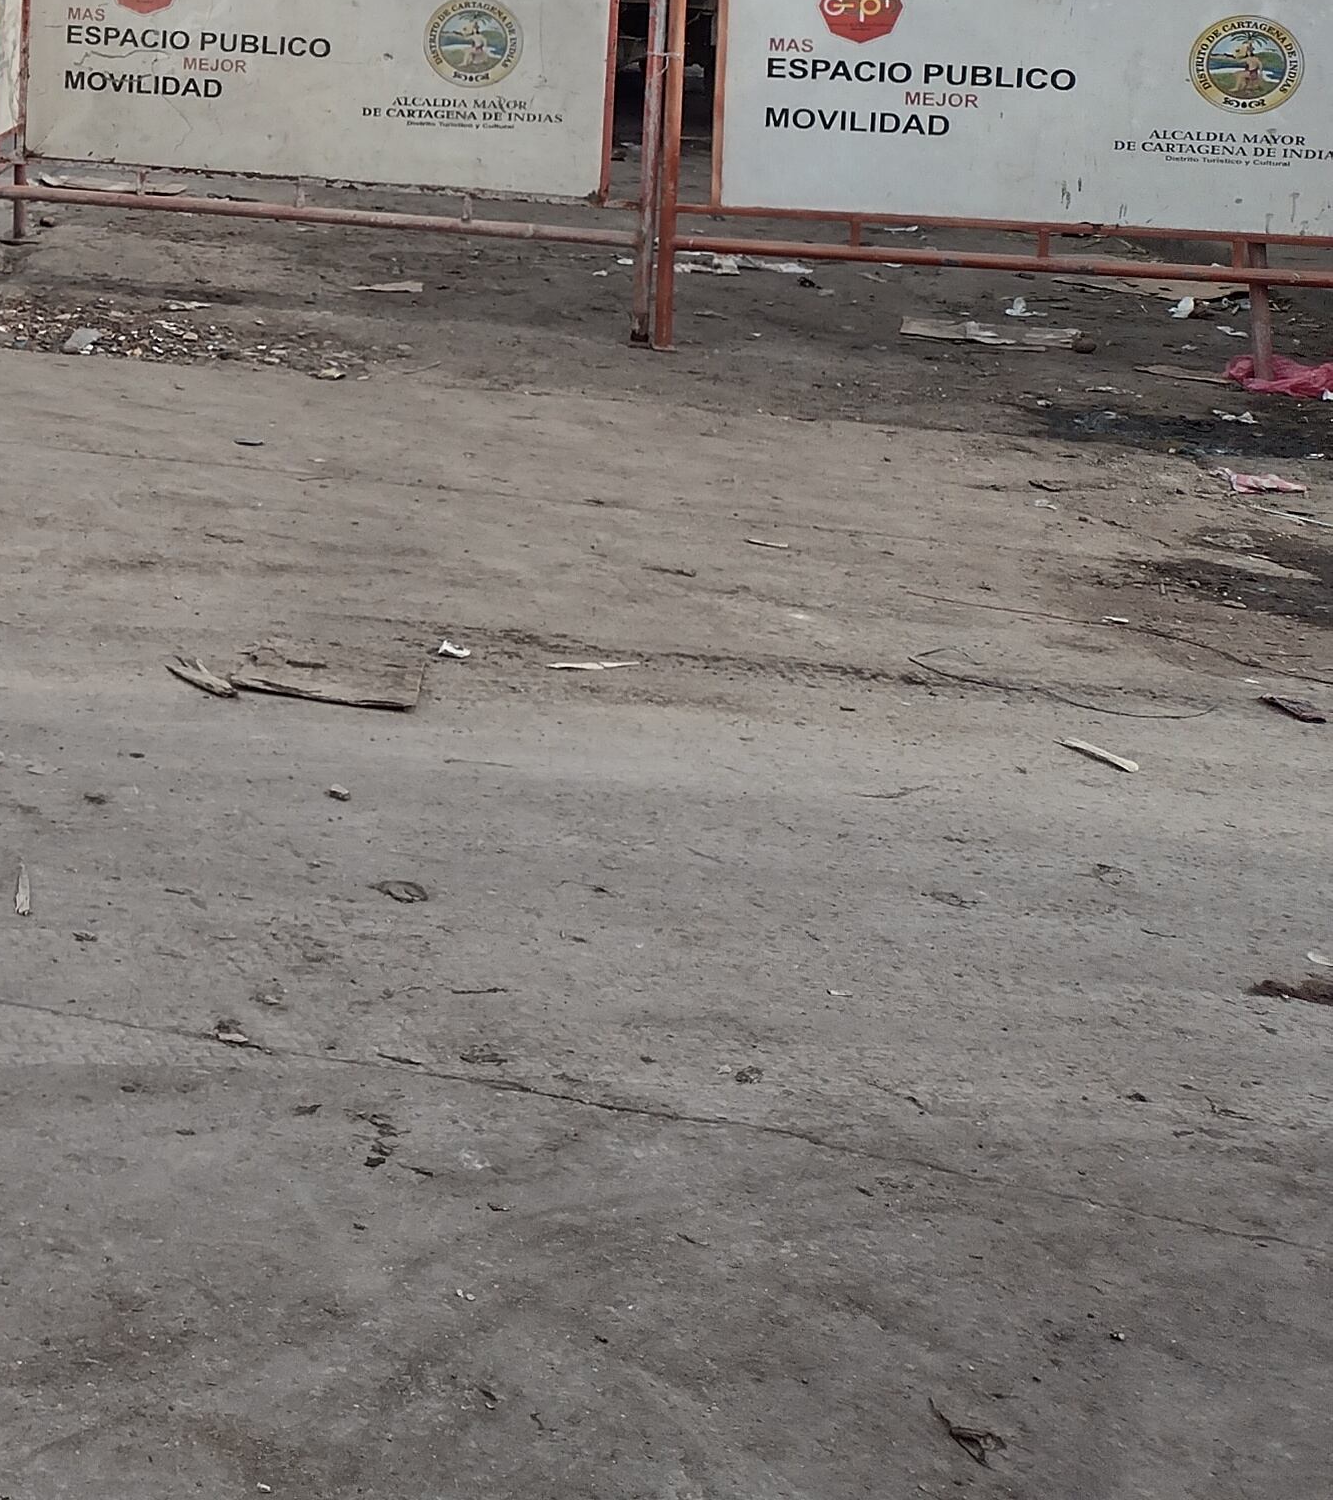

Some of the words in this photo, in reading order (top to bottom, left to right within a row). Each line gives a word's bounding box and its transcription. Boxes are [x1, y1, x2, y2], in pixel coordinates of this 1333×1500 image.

[67, 7, 106, 22] MAS
[450, 1, 509, 23] CARTAGENA
[66, 25, 191, 51] ESPACIO
[199, 31, 332, 58] PUBLICO
[769, 37, 814, 53] MAS
[183, 56, 247, 74] MEJOR
[1207, 29, 1222, 43] DE
[1222, 20, 1287, 45] CARTAGENA
[1279, 60, 1299, 94] INDIAS
[766, 57, 913, 84] ESPACIO
[923, 63, 1077, 91] PUBLICO
[64, 70, 223, 98] MOVILIDAD
[392, 96, 468, 110] ALCALDIA
[473, 99, 528, 112] MAYOR
[904, 91, 979, 109] MEJOR
[362, 107, 382, 118] DE
[385, 108, 478, 121] CARTAGENA
[482, 111, 504, 122] DE
[507, 112, 564, 124] INDIAS
[764, 106, 950, 137] MOVILIDAD
[1148, 129, 1237, 143] ALCALDIA
[1242, 132, 1306, 146] MAYOR
[1113, 140, 1136, 151] DE
[1141, 141, 1248, 158] CARTAGENA
[1253, 147, 1277, 158] DE
[1282, 148, 1333, 161] INDIA
[1165, 155, 1199, 163] Distrito
[1252, 159, 1291, 167] Cultural
